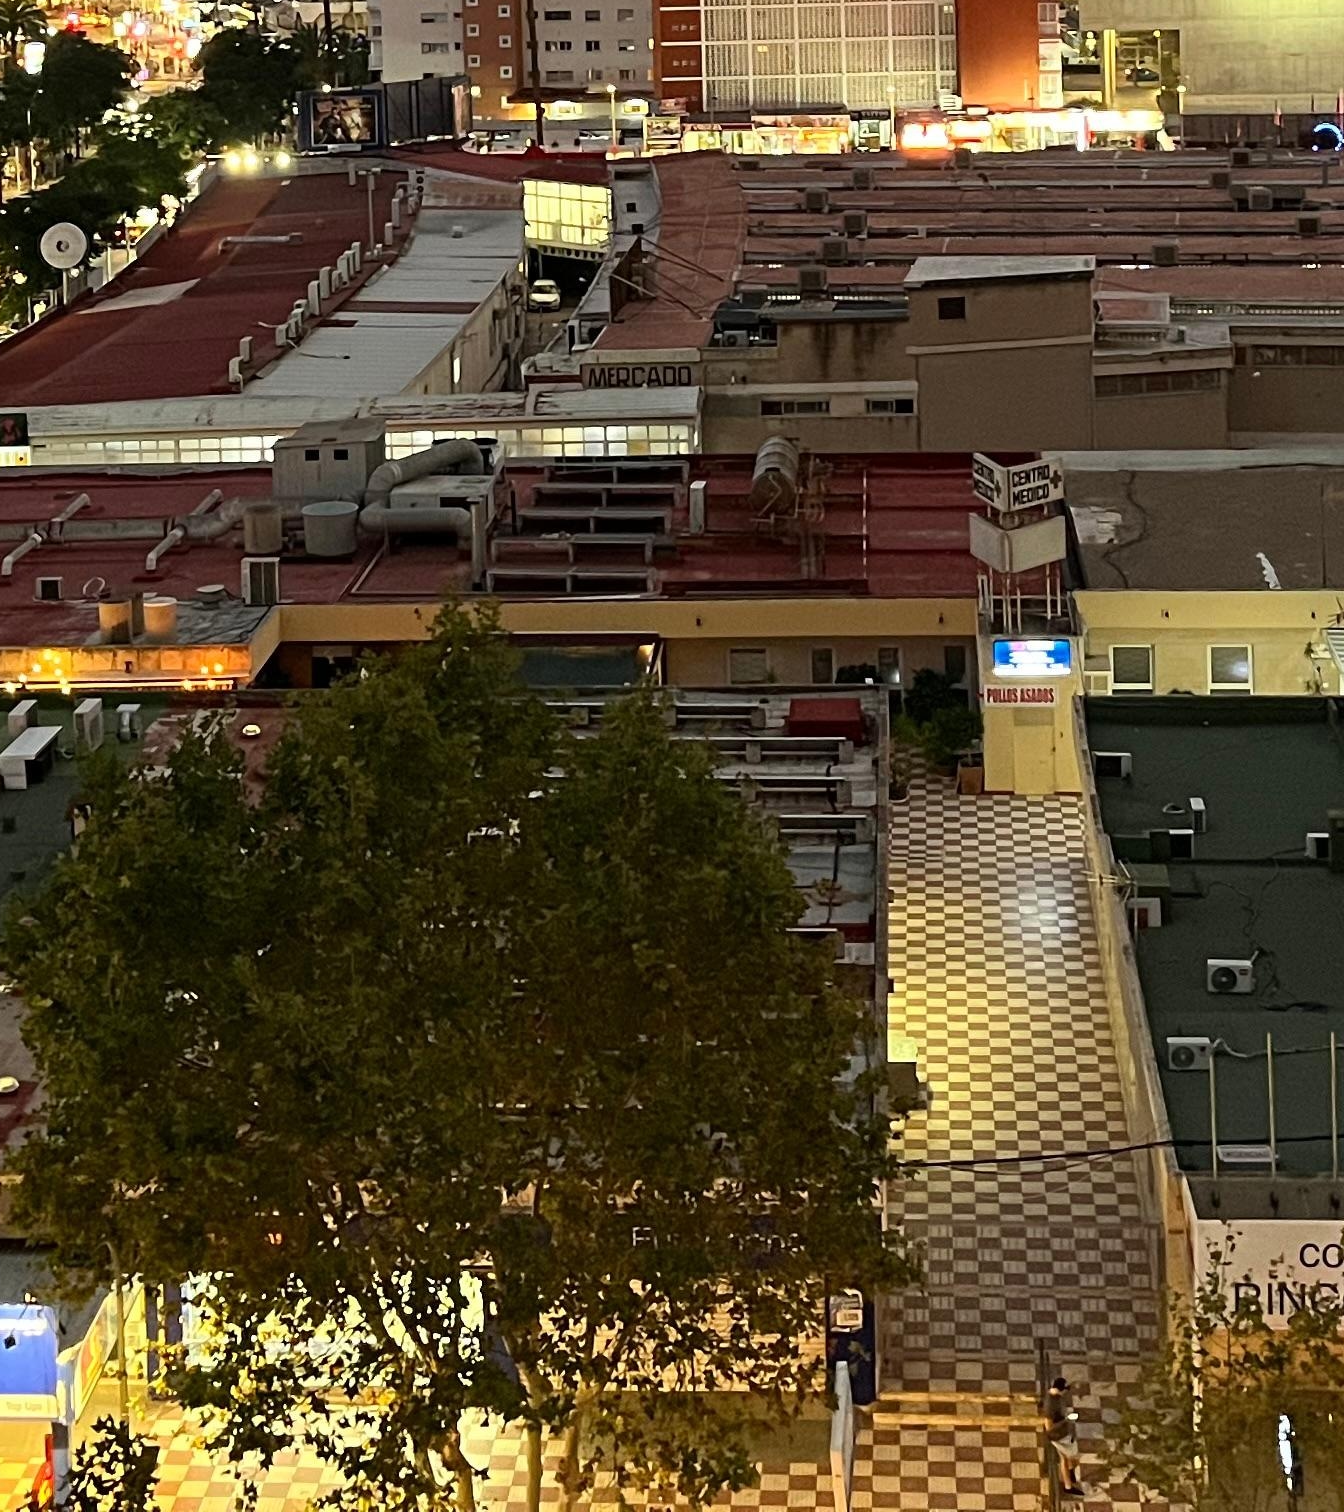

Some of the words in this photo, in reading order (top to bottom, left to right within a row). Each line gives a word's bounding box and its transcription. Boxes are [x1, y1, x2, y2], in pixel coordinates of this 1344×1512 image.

[588, 365, 692, 387] MERCADO
[1011, 464, 1050, 488] CENTRO
[1012, 483, 1050, 507] MEDICO
[986, 688, 1018, 703] POLLOS
[1019, 687, 1055, 703] ASADOS
